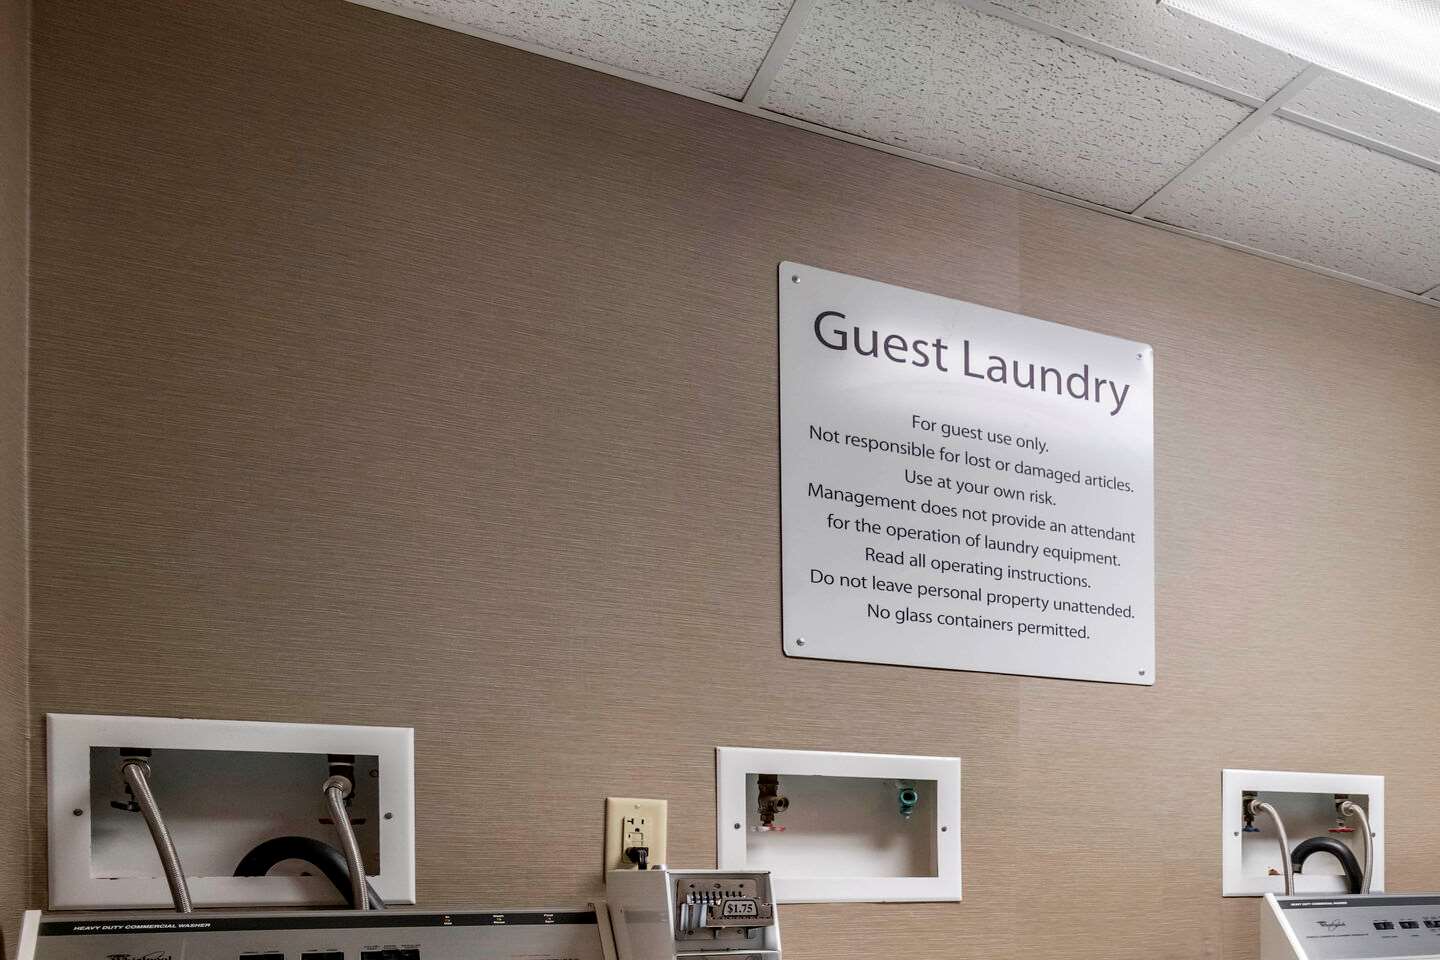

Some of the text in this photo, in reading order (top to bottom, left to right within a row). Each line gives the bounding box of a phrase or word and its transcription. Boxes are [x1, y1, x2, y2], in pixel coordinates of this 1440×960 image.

[813, 310, 1130, 417] Guest Laundry
[912, 414, 1049, 455] For guest use only.
[809, 424, 1134, 493] Not responsible for lost or damaged articles.
[904, 468, 1057, 506] Use at your own risk.
[807, 482, 1136, 544] Management does not provide an attendant
[827, 511, 1121, 567] for the operation of laundry equipment.
[865, 546, 1092, 589] Read all operating instructions.
[810, 568, 1135, 619] Do not leave personal property unattended.
[867, 602, 1090, 640] No glass containers permitted.
[727, 903, 753, 914] $1.75
